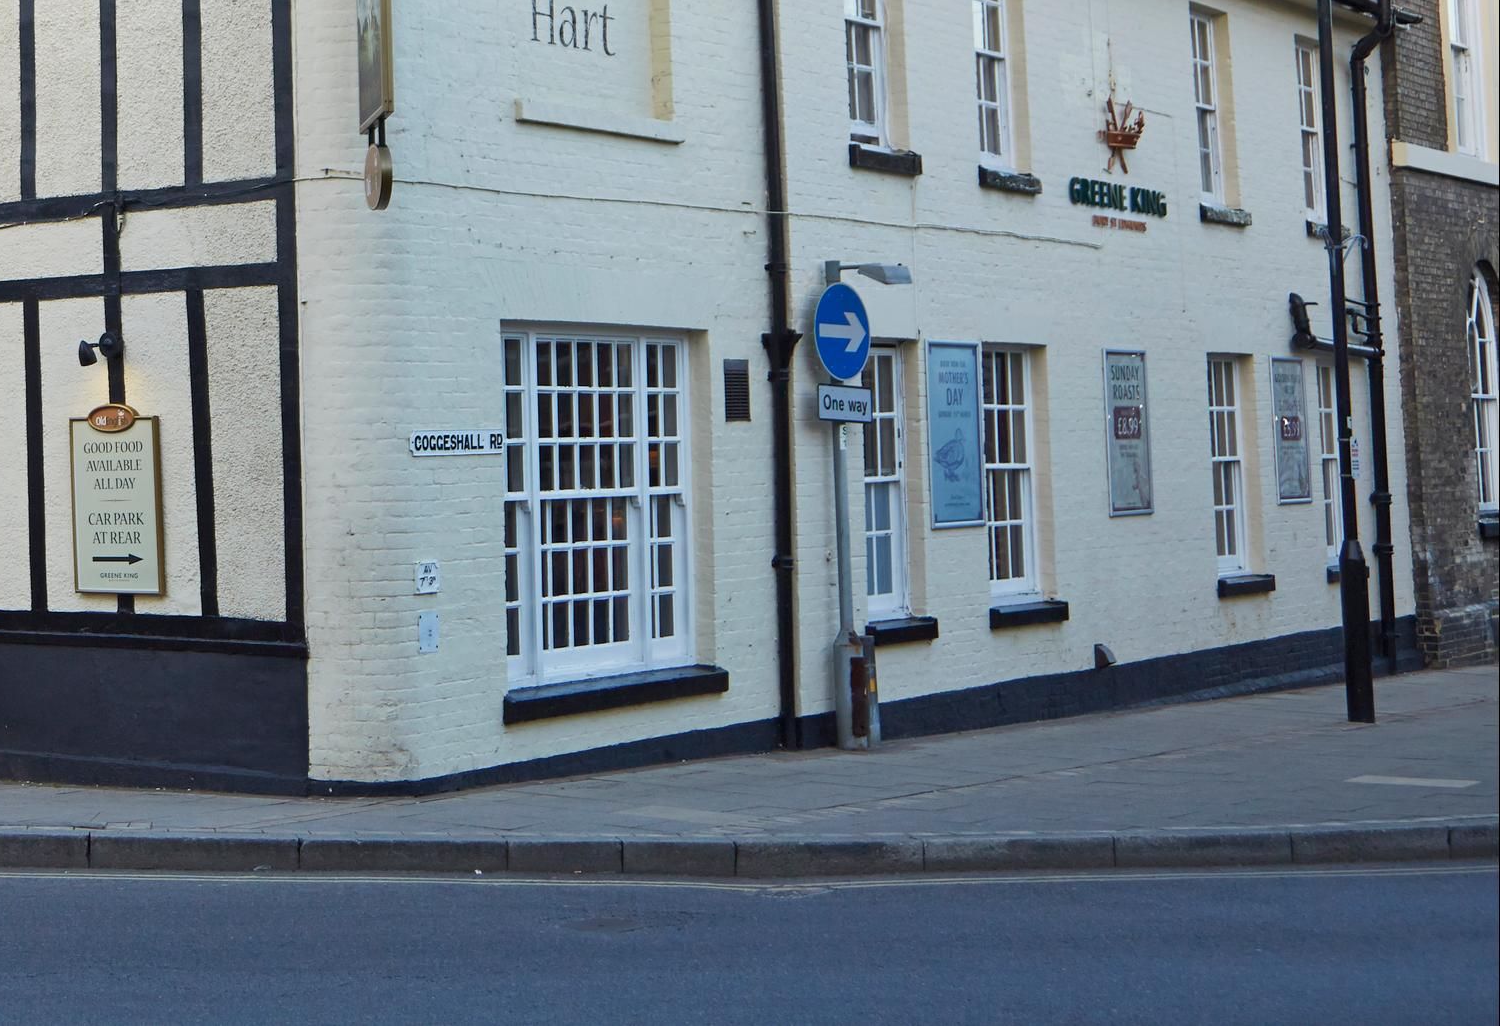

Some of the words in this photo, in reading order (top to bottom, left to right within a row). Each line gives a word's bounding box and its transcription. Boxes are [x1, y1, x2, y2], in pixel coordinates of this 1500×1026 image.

[1069, 176, 1128, 211] GREENE
[1129, 186, 1167, 219] KING
[1110, 365, 1140, 381] SUNDAY
[946, 388, 964, 406] DAY
[1112, 384, 1140, 400] ROASTS
[823, 394, 845, 411] One
[847, 399, 868, 416] way
[1117, 417, 1139, 435] £8.99
[83, 442, 113, 454] GOOD
[115, 440, 143, 453] FOOD
[414, 433, 484, 451] COGGESHALL
[86, 459, 142, 472] AVAILABLE
[93, 478, 114, 490] ALL
[115, 477, 136, 490] DAY
[88, 512, 112, 526] CAR
[114, 512, 145, 526] PARK
[92, 531, 108, 544] AT
[110, 531, 142, 544] REAR
